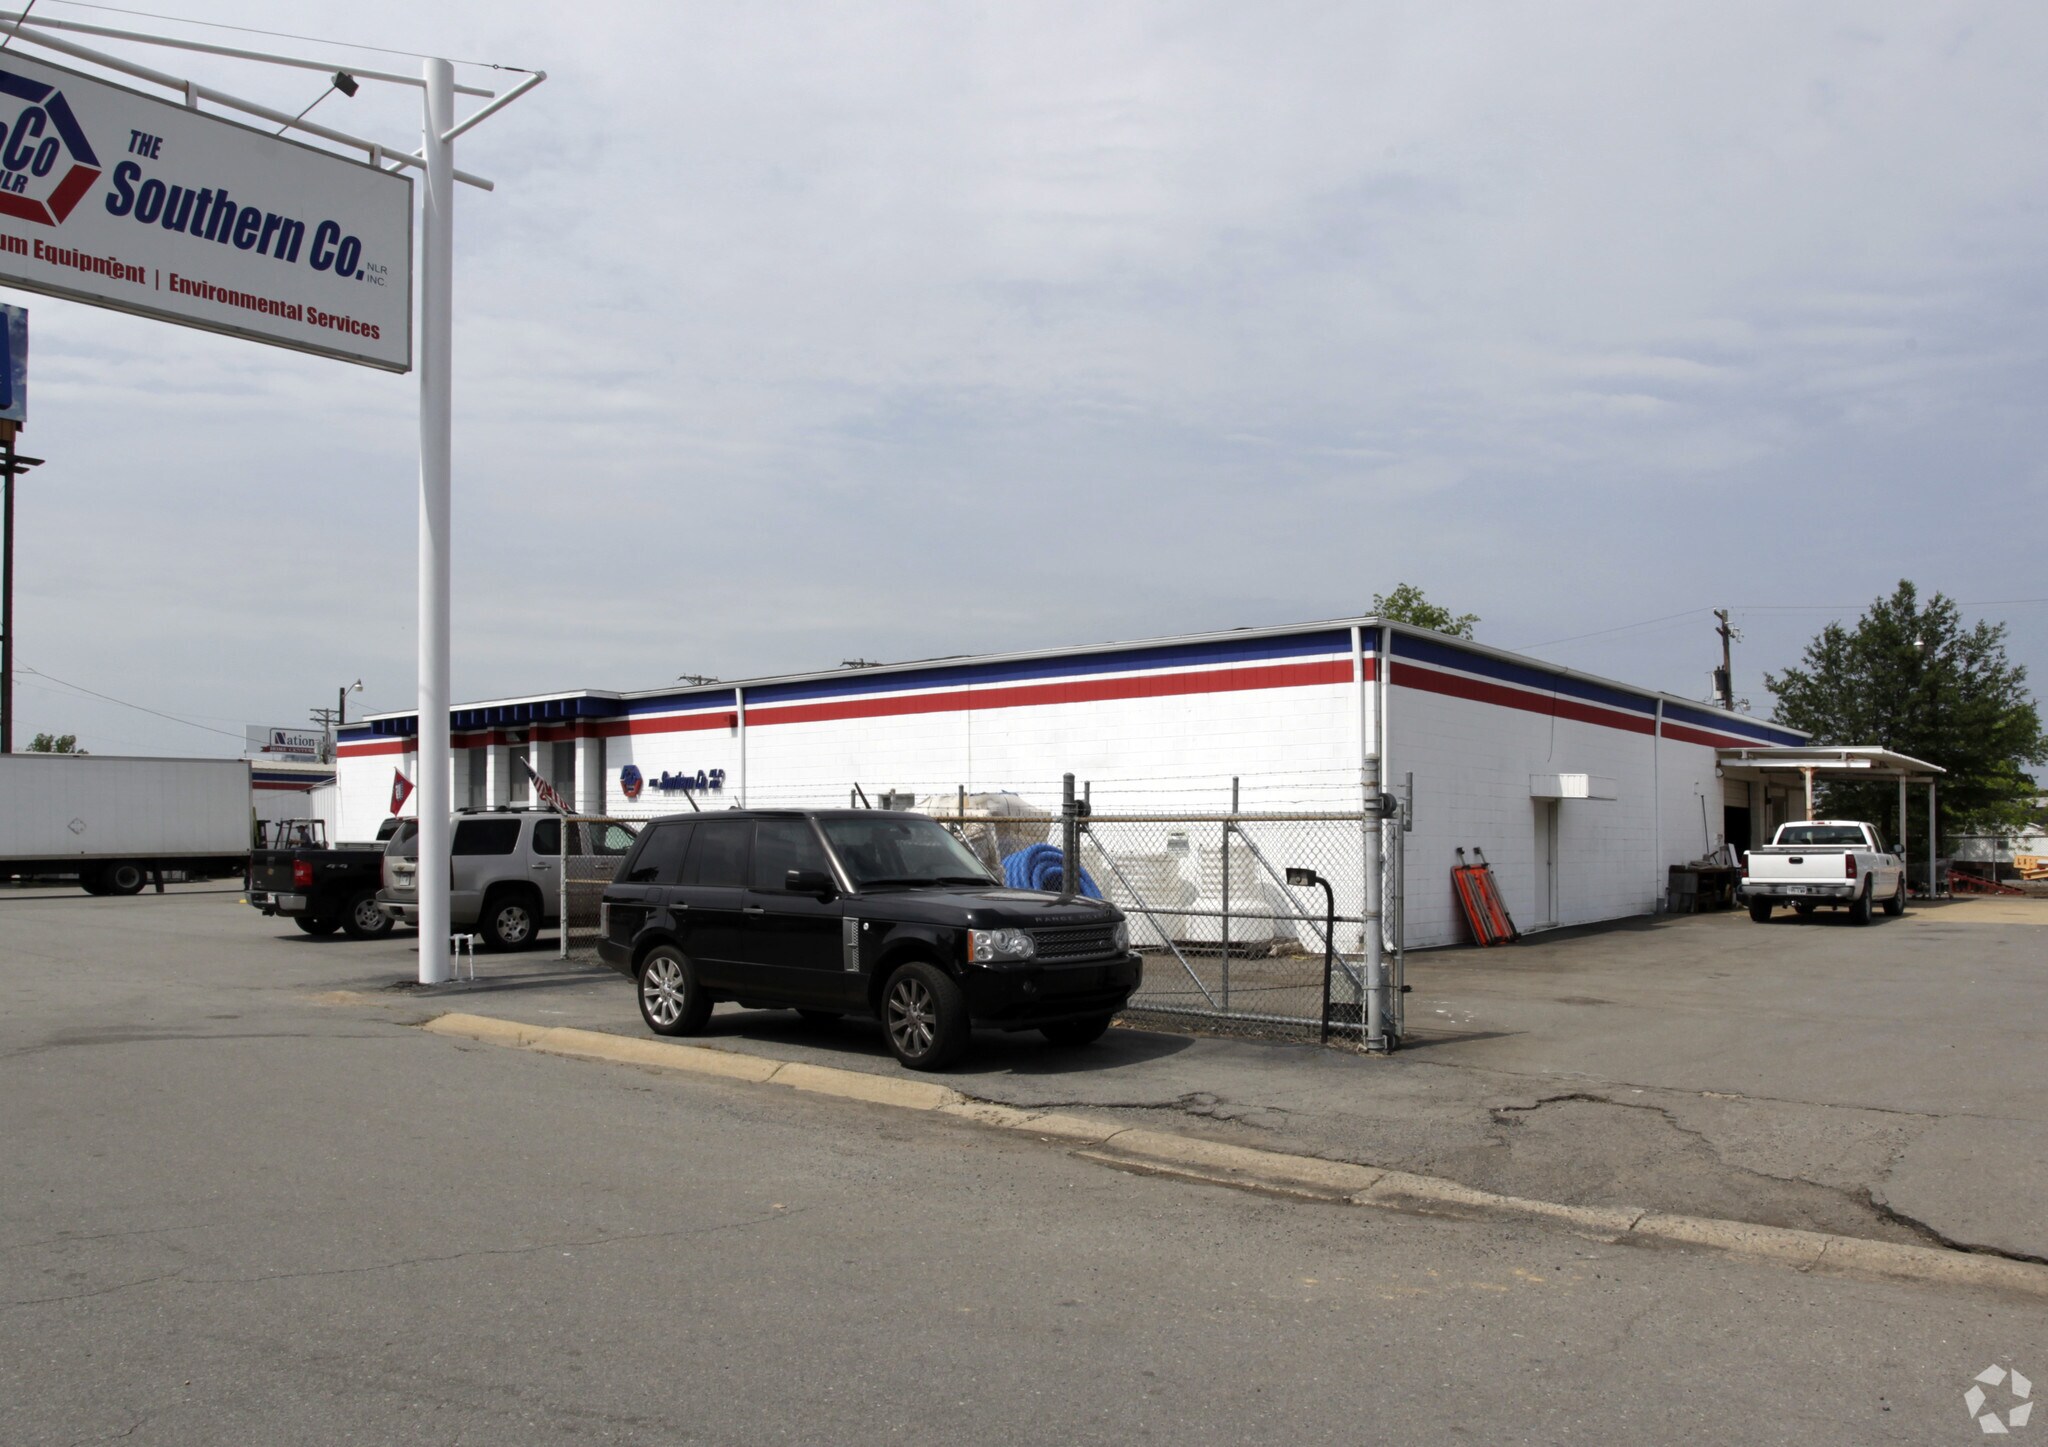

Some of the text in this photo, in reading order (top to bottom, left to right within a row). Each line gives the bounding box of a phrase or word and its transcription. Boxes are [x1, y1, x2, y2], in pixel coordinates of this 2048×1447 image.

[0, 106, 60, 177] Co
[128, 129, 163, 160] THE
[0, 169, 28, 194] LR
[105, 160, 365, 281] Southern Co.
[34, 238, 146, 285] Equipment
[169, 272, 302, 322] Environmental
[307, 306, 380, 339] Services
[367, 262, 388, 275] NLR
